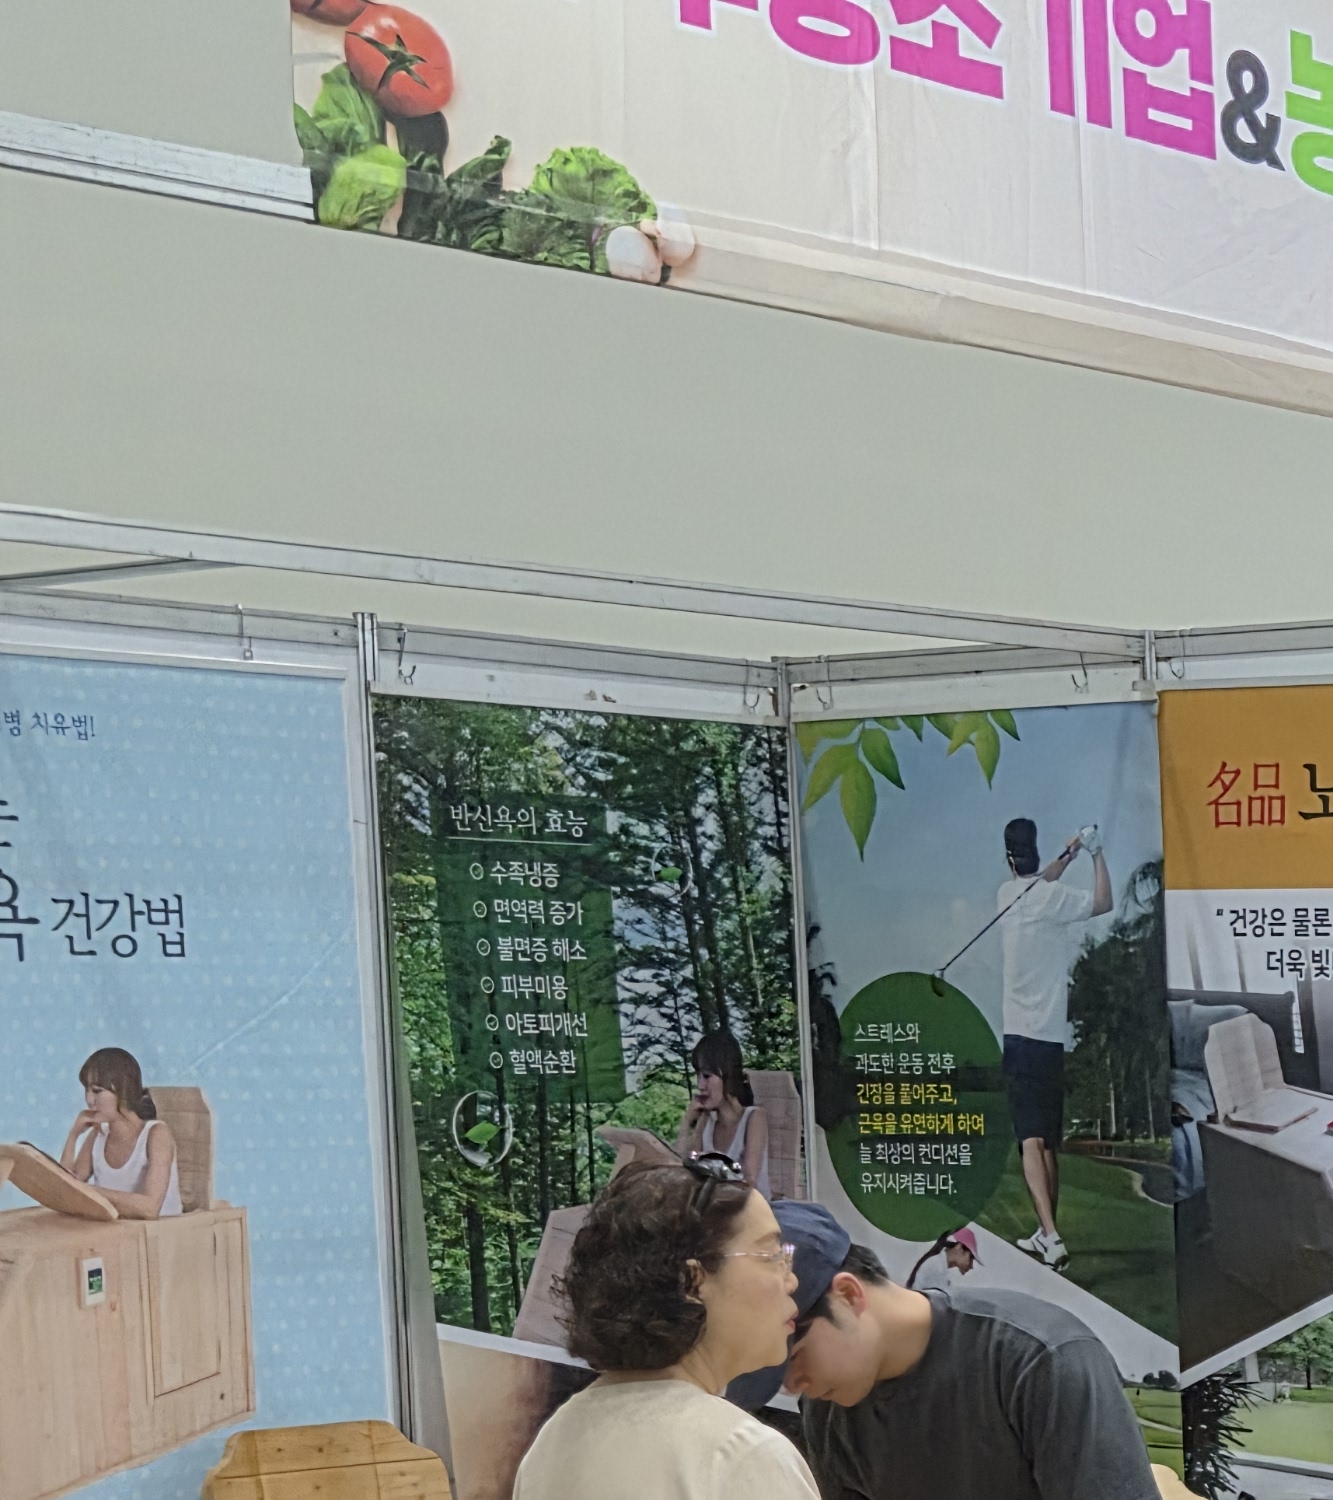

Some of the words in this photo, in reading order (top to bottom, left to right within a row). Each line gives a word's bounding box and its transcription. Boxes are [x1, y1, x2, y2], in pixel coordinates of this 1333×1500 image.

[30, 711, 96, 741] 치유법!
[1206, 760, 1287, 829] 名品
[450, 805, 537, 834] 반신욕의
[544, 808, 588, 838] 효능
[490, 861, 560, 887] 수족냉증
[50, 892, 187, 958] 건강법
[493, 899, 545, 926] 면역력
[549, 900, 584, 926] 증가
[497, 937, 549, 962] 불면증
[553, 938, 587, 961] 해소
[1266, 949, 1306, 979] 더욱
[501, 974, 569, 1000] 피부미용
[505, 1012, 588, 1037] 아토피개선
[854, 1022, 920, 1043] 스트레스와
[509, 1048, 576, 1074] 혈액순환
[855, 1053, 894, 1074] 과도한
[898, 1053, 925, 1074] 운동
[928, 1053, 956, 1074] 전후
[856, 1084, 896, 1105] 긴장을
[898, 1084, 958, 1106] 풀어주고,
[858, 1113, 898, 1135] 근육을
[900, 1113, 954, 1135] 유연하게
[957, 1113, 985, 1135] 하여
[859, 1143, 872, 1164] 늘
[875, 1143, 915, 1165] 최상의
[918, 1143, 973, 1166] 컨디션을
[860, 1172, 958, 1195] 유지시켜줍니다.
